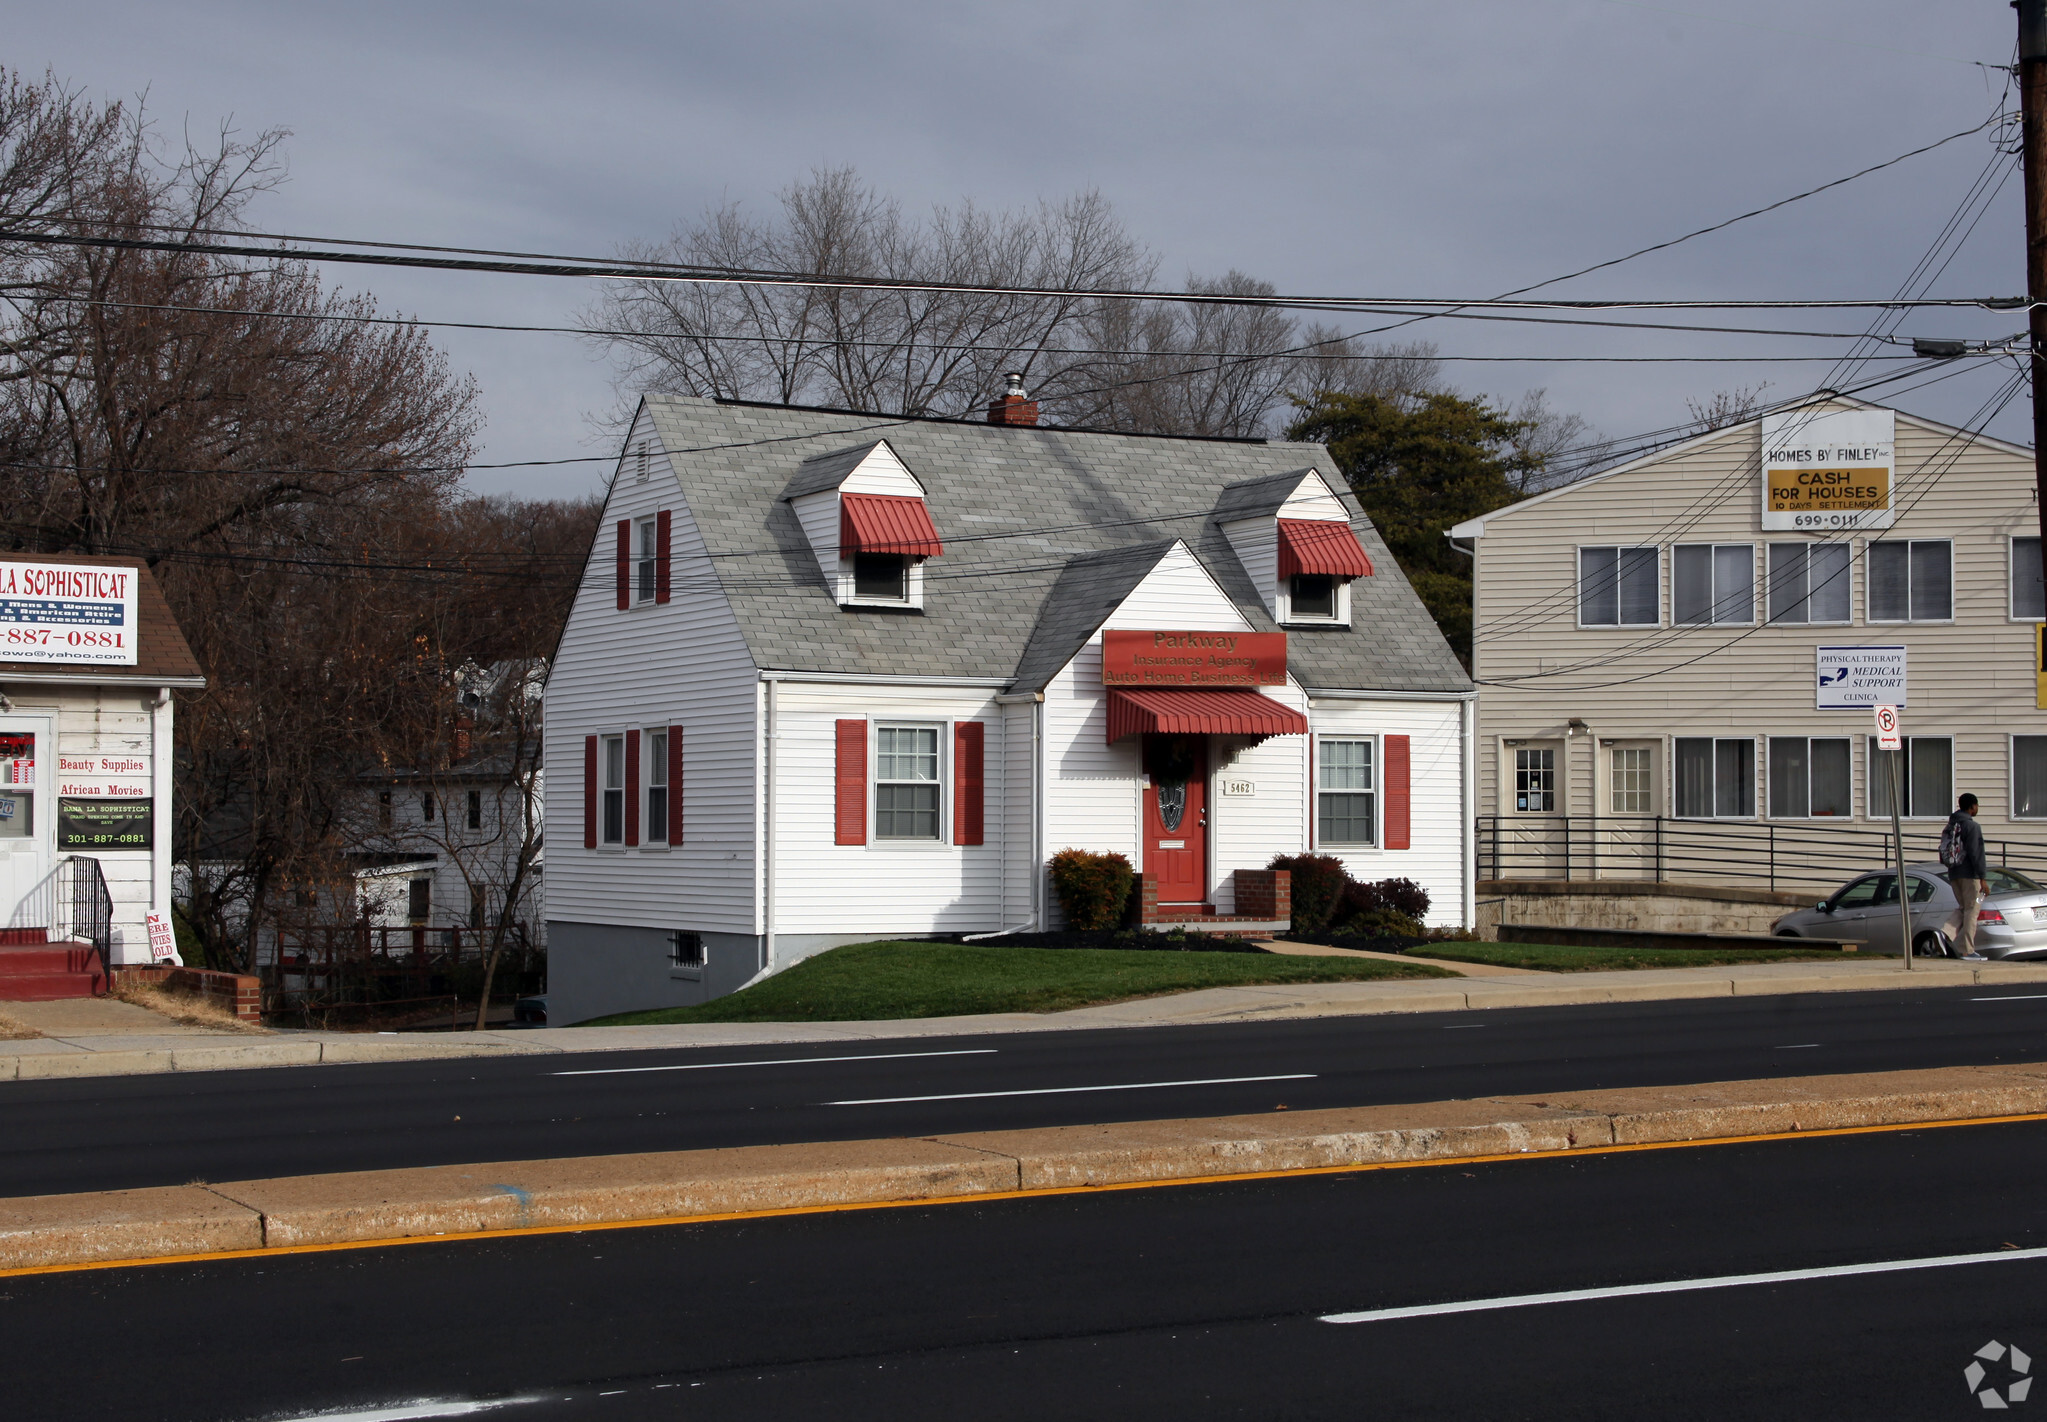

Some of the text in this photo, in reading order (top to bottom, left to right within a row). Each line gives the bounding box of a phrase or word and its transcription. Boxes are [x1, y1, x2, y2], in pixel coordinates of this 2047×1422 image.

[1769, 450, 1812, 462] HOMES
[1818, 449, 1831, 461] BY
[1837, 448, 1879, 461] FINLEY
[1798, 472, 1850, 485] CASH
[1773, 486, 1877, 500] FOR HOUSES
[1819, 500, 1881, 509] SETTLEMENT
[0, 568, 128, 599] LA SOPHISTICAT
[37, 616, 110, 624] Accessories
[1154, 632, 1238, 653] Parkway
[1133, 654, 1258, 669] Insurance Agency
[1862, 655, 1902, 663] THERAPY
[1106, 670, 1285, 684] Auto Home Business Life
[1852, 667, 1903, 676] MEDICAL
[1852, 679, 1904, 688] SUPPORT
[1843, 693, 1878, 701] CLINICA
[59, 758, 144, 773] Beauty Supplies
[61, 784, 144, 795] African Movies
[1230, 783, 1250, 793] 5462
[67, 834, 145, 843] 301-887-0881
[154, 945, 173, 957] OLD
